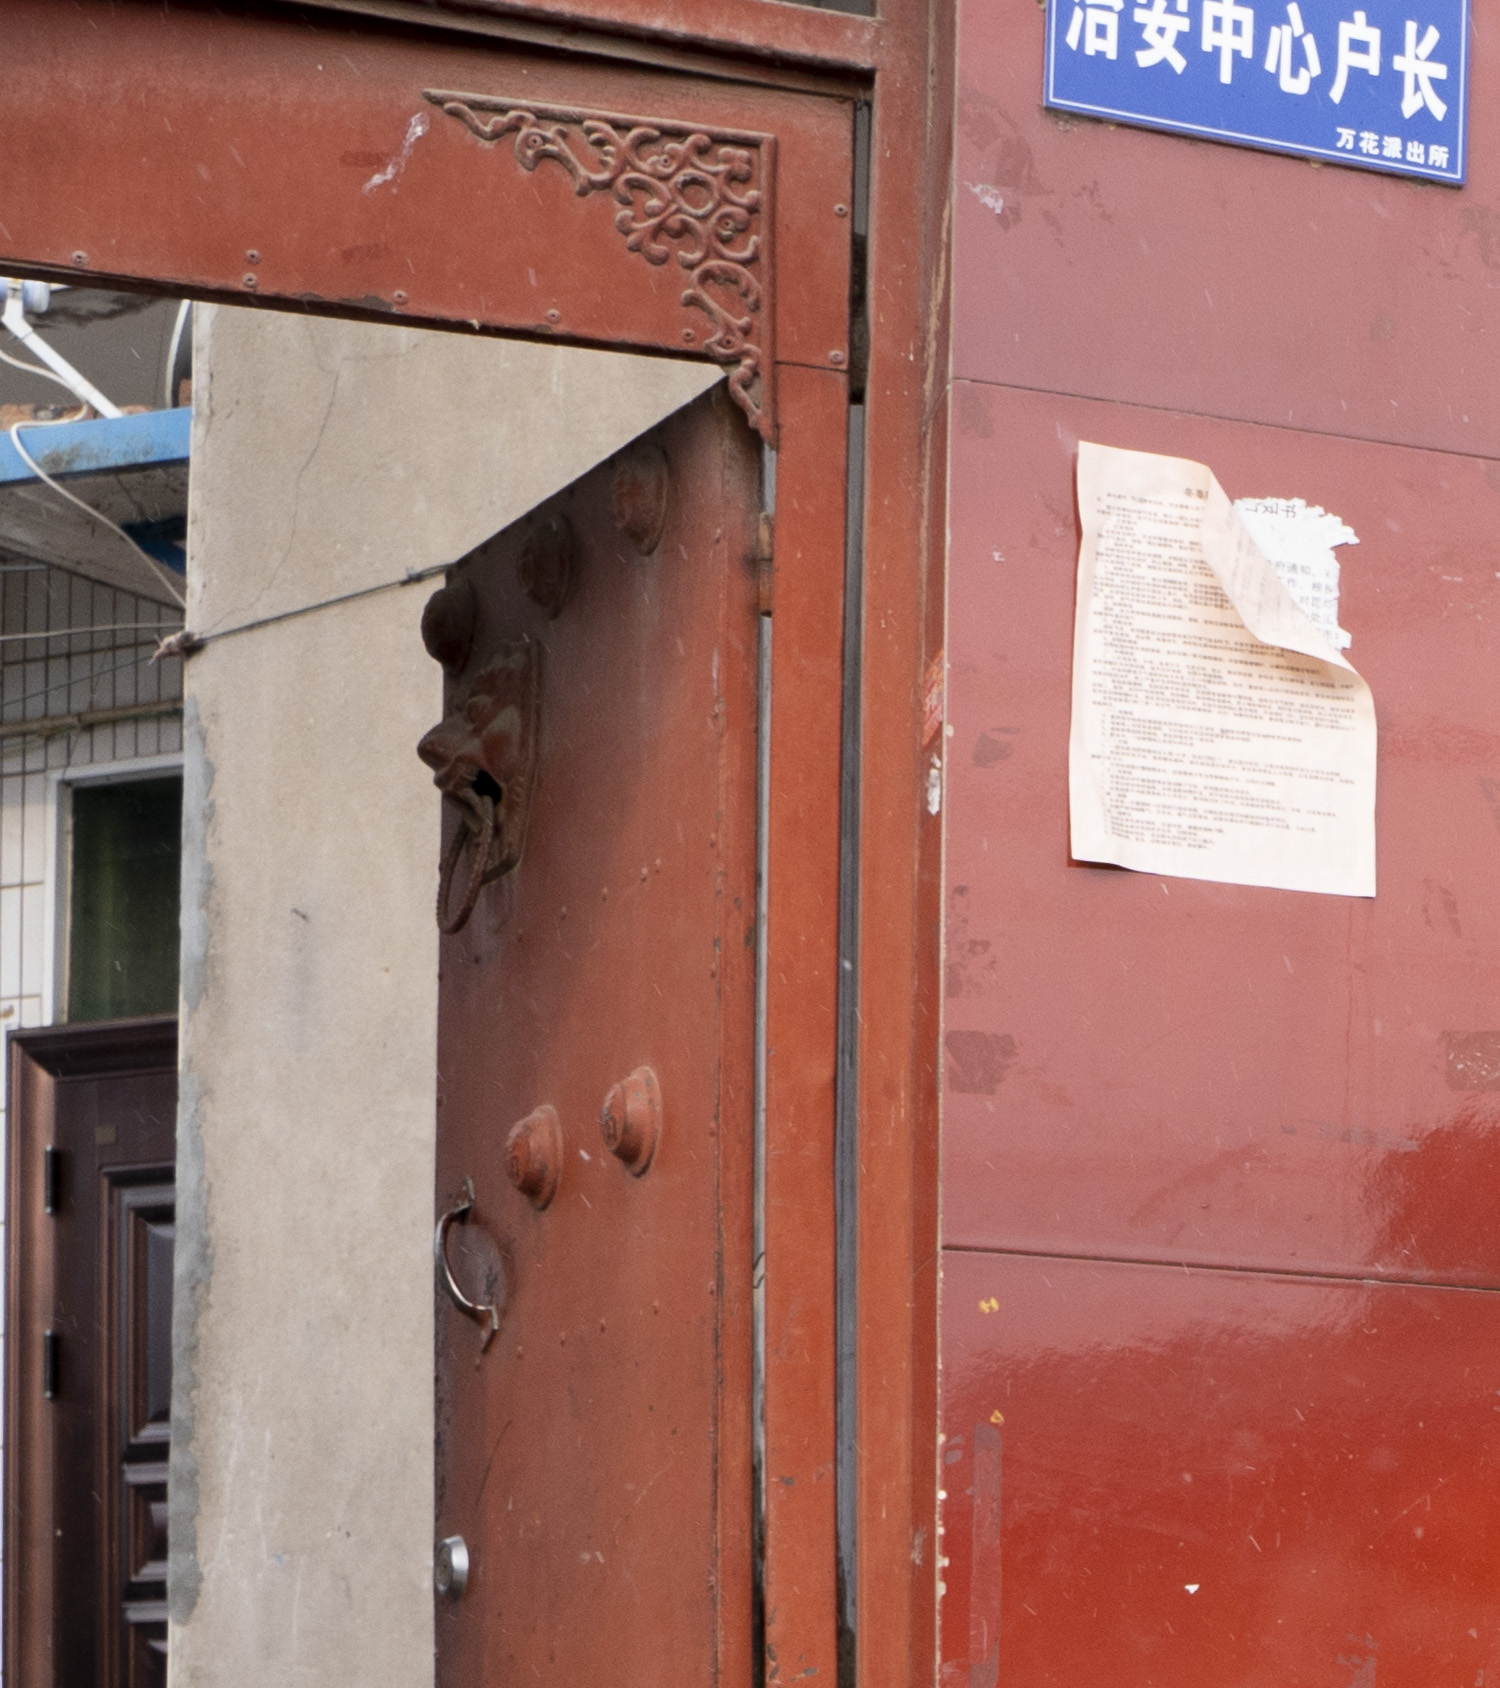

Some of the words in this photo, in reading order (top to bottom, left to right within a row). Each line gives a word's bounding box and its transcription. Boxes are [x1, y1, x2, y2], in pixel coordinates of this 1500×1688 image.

[1066, 0, 1448, 121] 治安中心户长
[1336, 127, 1449, 169] 万花派出所
